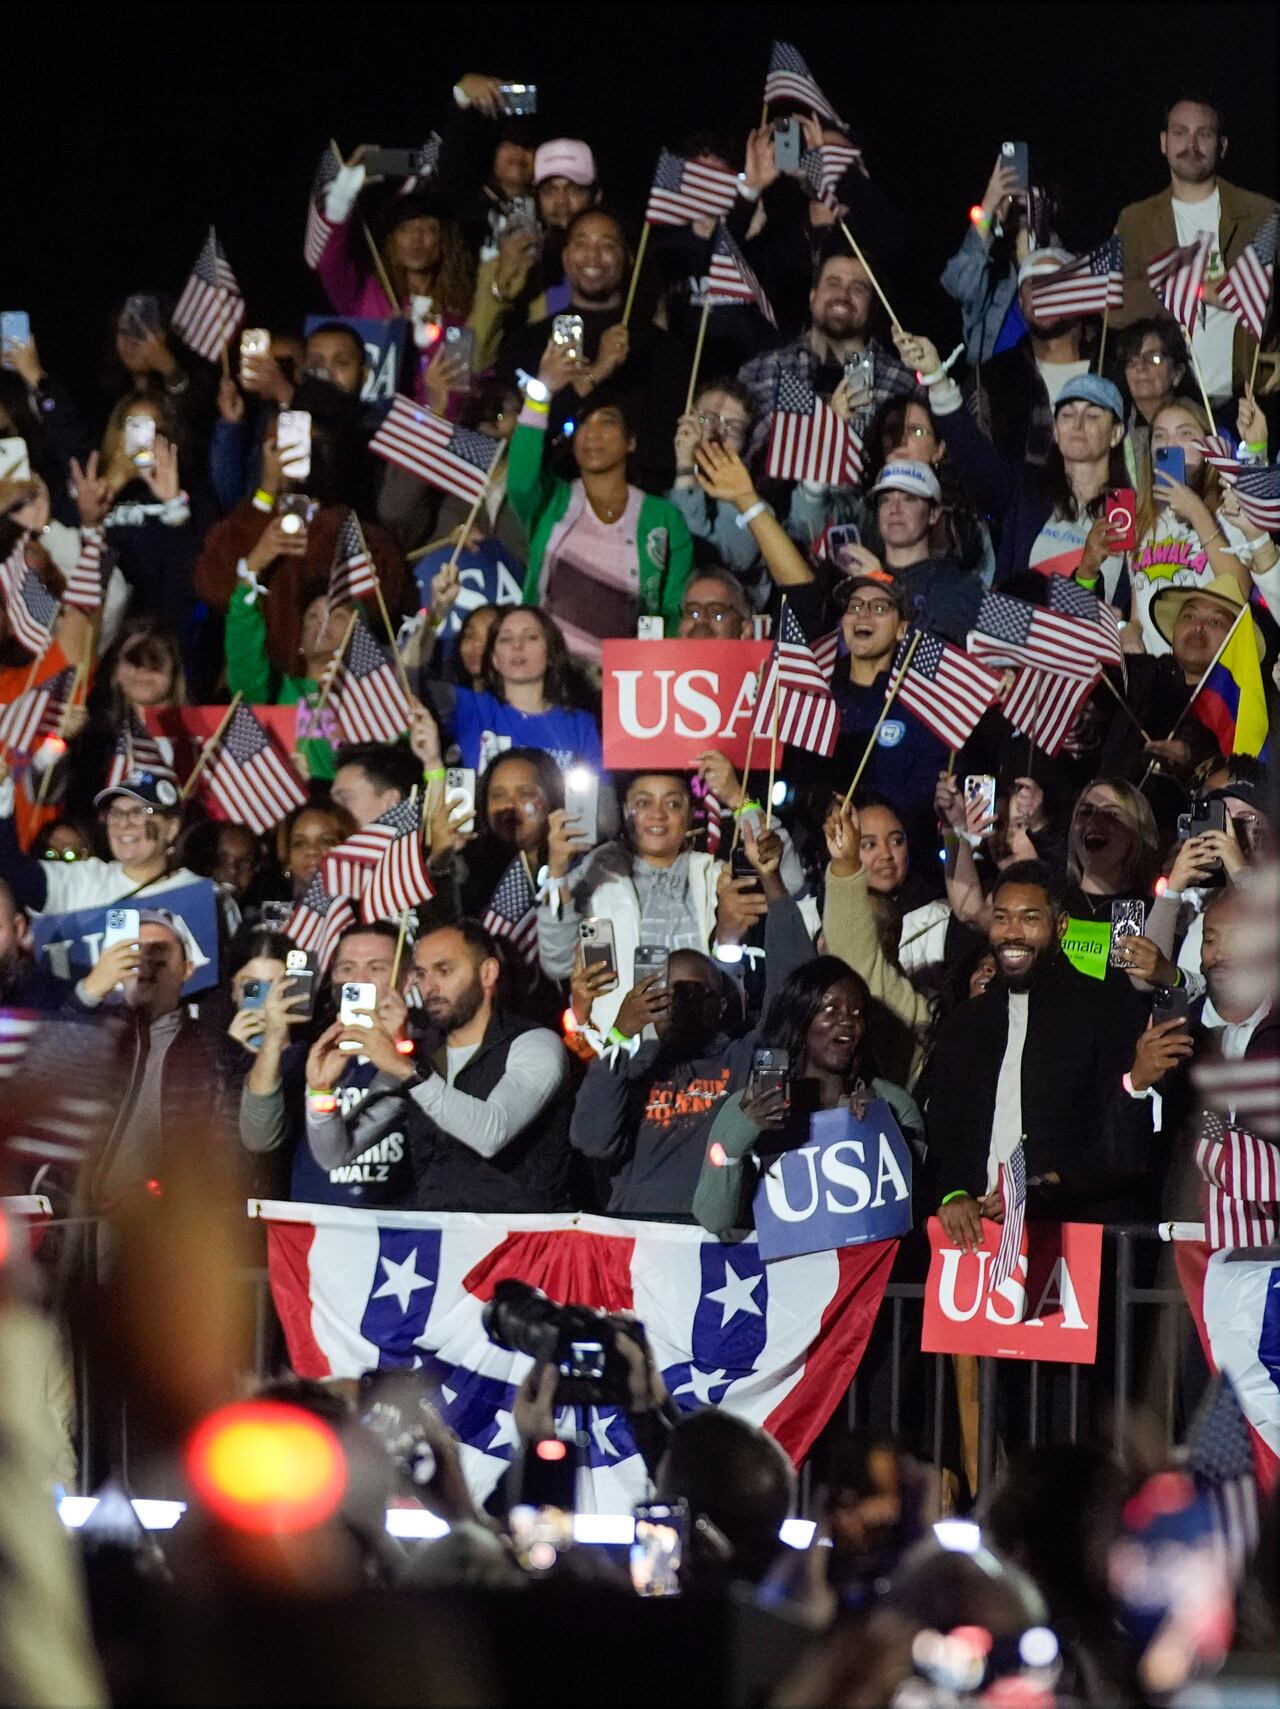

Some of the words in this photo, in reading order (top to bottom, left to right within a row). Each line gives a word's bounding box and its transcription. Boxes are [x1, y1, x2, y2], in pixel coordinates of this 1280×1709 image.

[434, 560, 524, 636] SA
[611, 669, 773, 739] USA
[1061, 938, 1103, 955] amala
[329, 1164, 390, 1184] WALZ
[764, 1132, 910, 1223] USA
[938, 1248, 1089, 1330] USA
